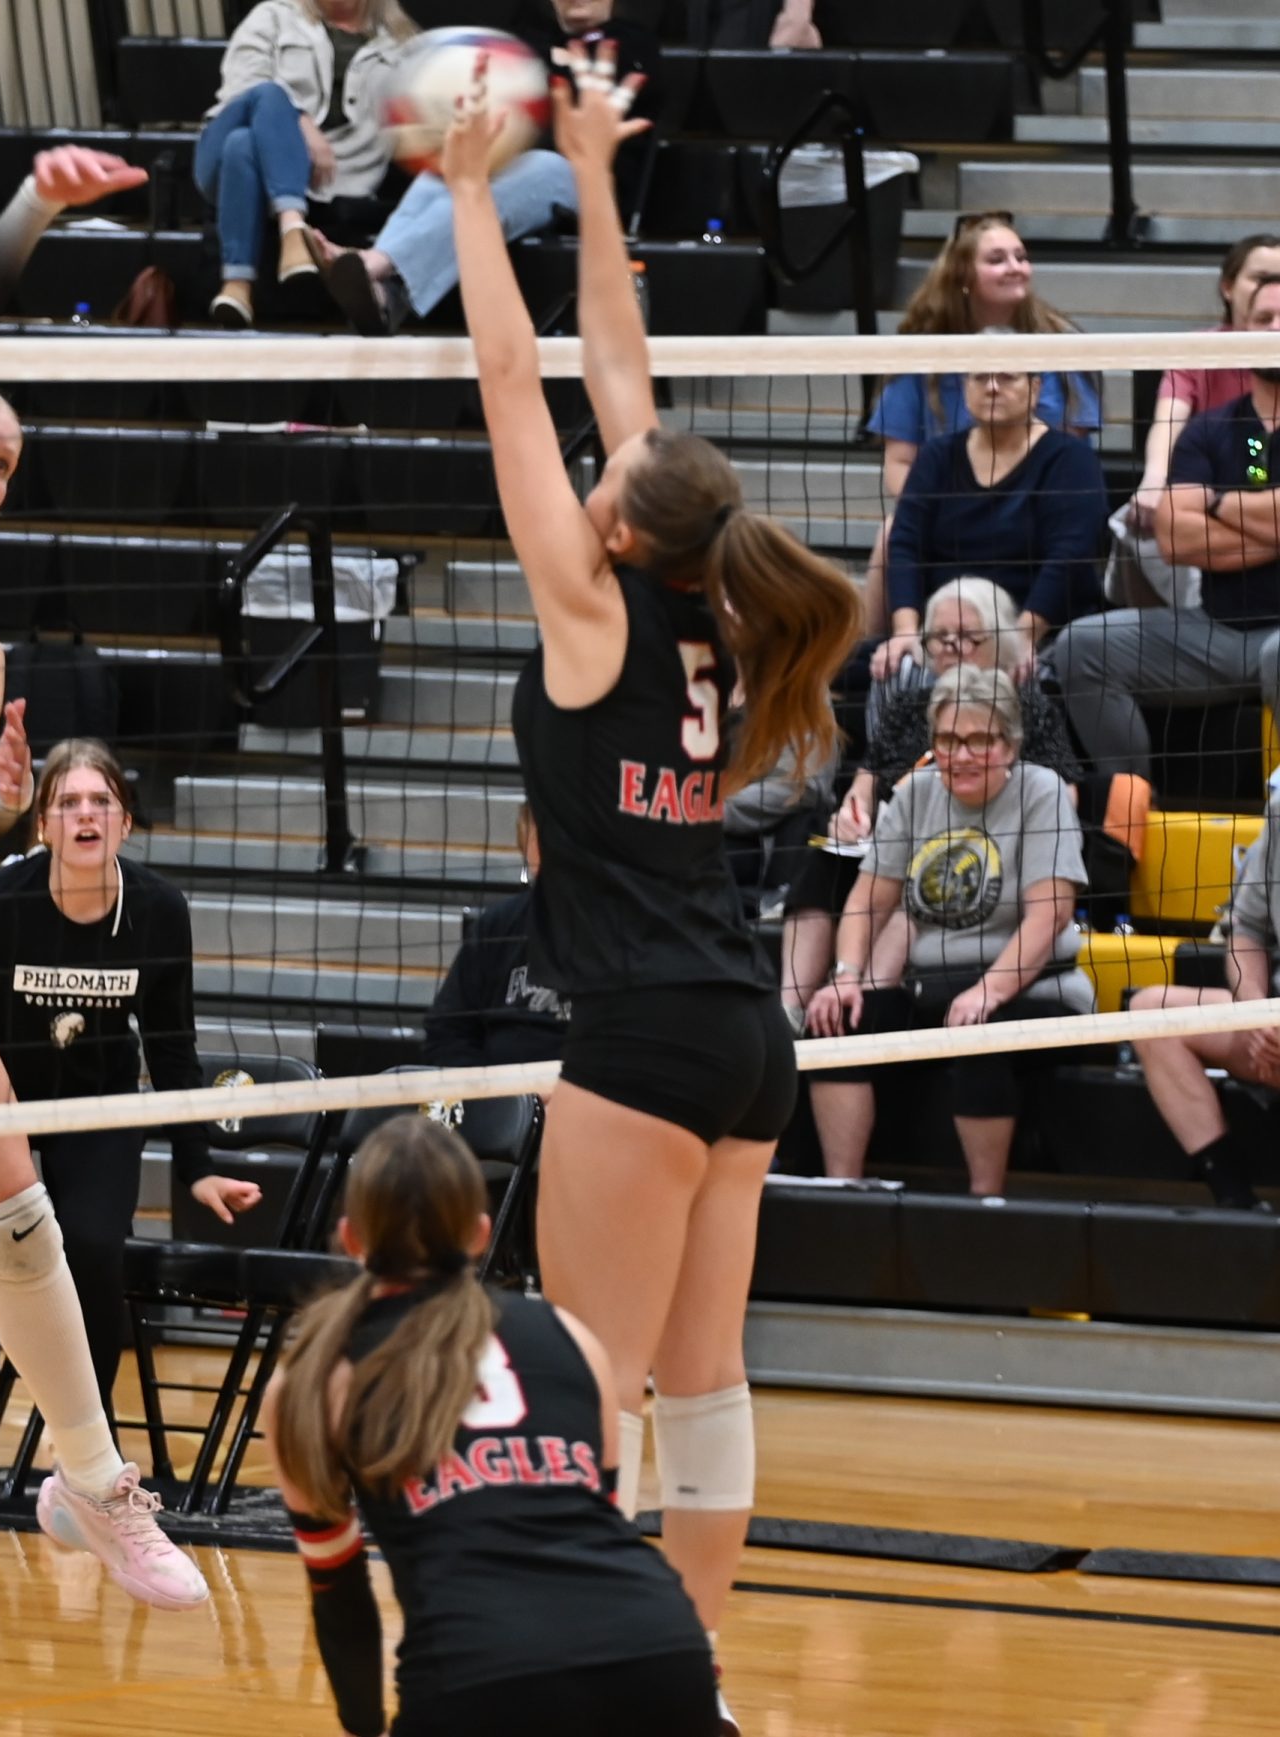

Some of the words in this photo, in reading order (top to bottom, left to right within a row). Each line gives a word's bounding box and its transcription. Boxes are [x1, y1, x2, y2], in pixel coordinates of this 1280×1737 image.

[677, 640, 720, 760] 5
[618, 760, 726, 825] EAGL
[22, 971, 131, 992] PHILOMATH
[24, 994, 121, 1008] VOLLEYBALL
[405, 1436, 600, 1516] EAGLES
